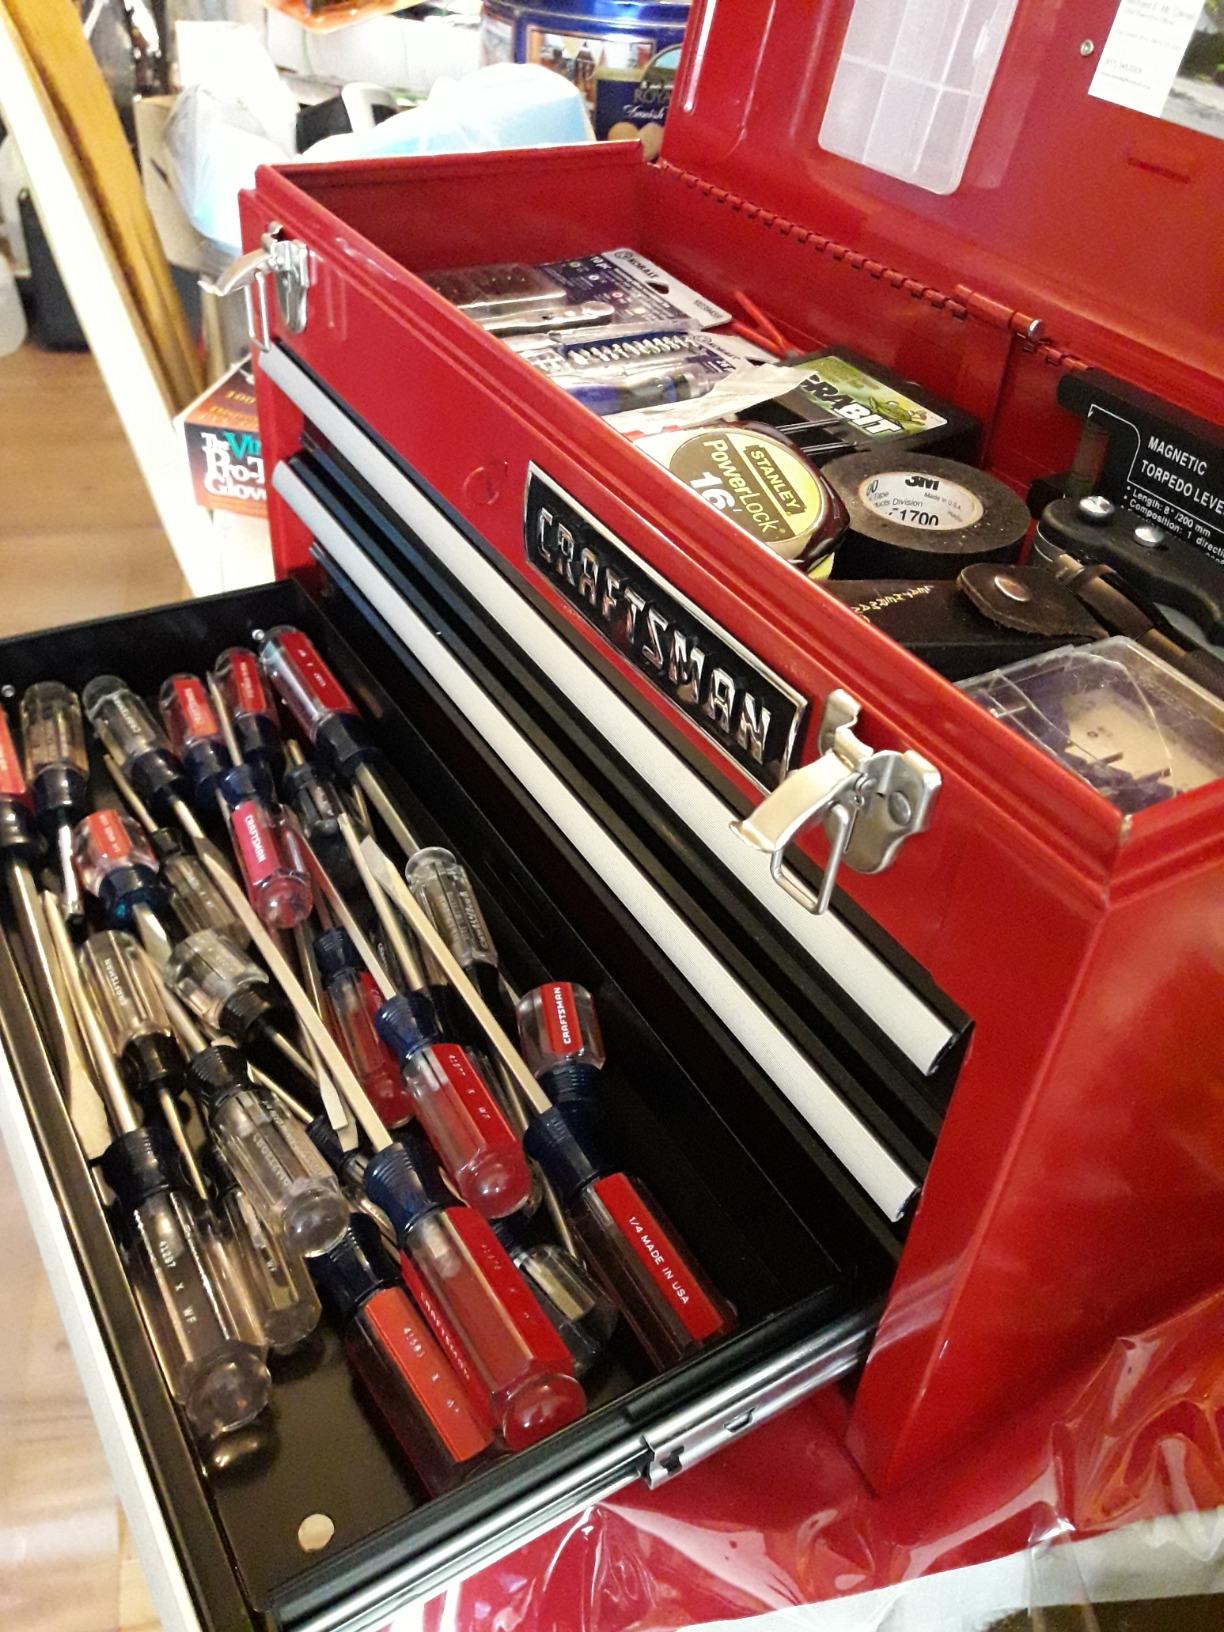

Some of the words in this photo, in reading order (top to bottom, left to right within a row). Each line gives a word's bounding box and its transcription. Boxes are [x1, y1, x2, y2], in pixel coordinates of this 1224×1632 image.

[201, 432, 229, 451] The
[1148, 436, 1208, 476] MAGNETIC
[703, 439, 779, 533] PowerLock
[749, 449, 801, 509] STANLEY
[892, 498, 923, 508] Division
[905, 475, 940, 490] 3M
[1141, 459, 1193, 497] TORPEDO
[1193, 488, 1224, 515] LEVE
[900, 509, 939, 526] 1700
[1129, 499, 1183, 534] Composition:
[1132, 489, 1163, 511] Length:
[1195, 524, 1211, 537] mm
[537, 507, 772, 766] CRAFTSMAN
[244, 814, 266, 864] CRAFTSMAN
[103, 958, 127, 1007] CRAFTSMAN
[554, 986, 571, 1046] CRAFTSMAN
[629, 1216, 644, 1234] 1/4
[640, 1234, 665, 1265] MADE
[662, 1267, 674, 1280] IN
[672, 1281, 690, 1304] USA
